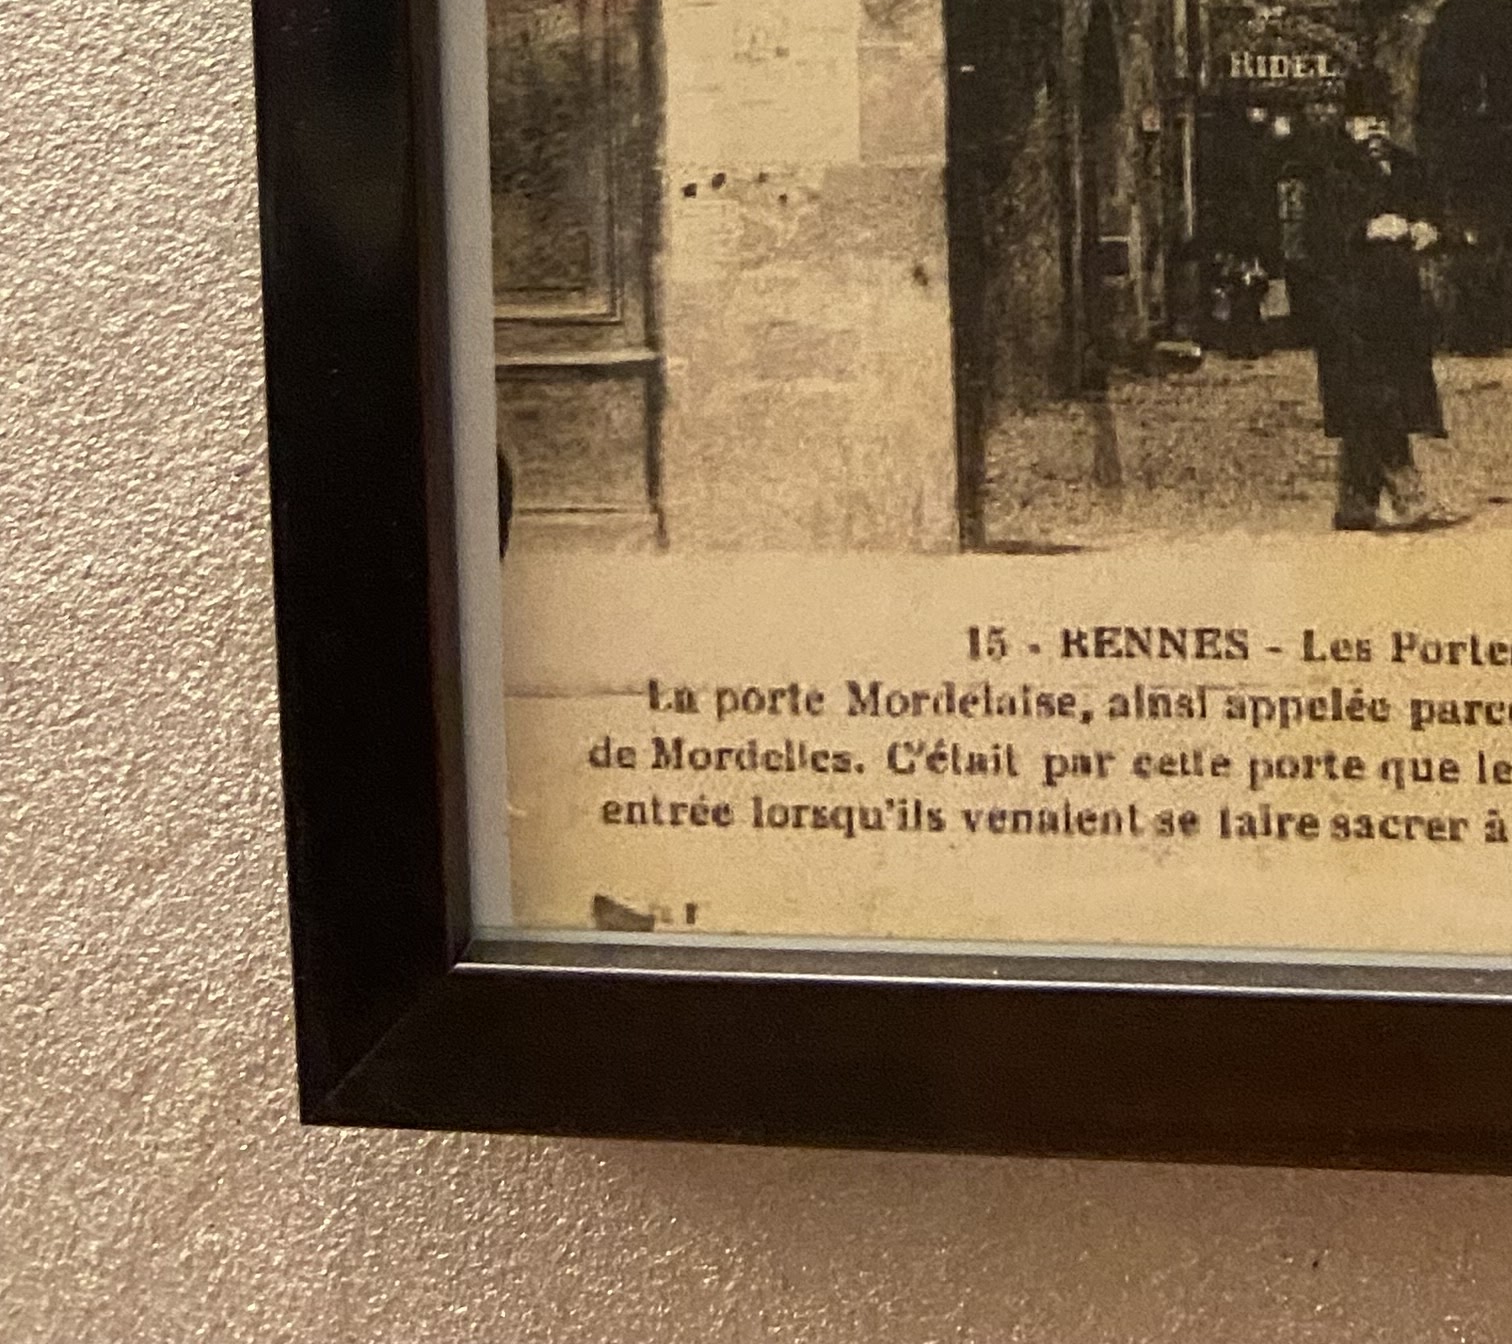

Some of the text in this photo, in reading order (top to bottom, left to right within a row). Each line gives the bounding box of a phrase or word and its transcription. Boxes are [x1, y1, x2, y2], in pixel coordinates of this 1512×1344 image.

[967, 626, 1008, 660] 15
[1061, 627, 1249, 661] RENNES
[1303, 629, 1371, 663] Les
[648, 680, 697, 712] La
[715, 683, 825, 720] porte
[847, 682, 1093, 724] Mordelaise,
[1108, 684, 1207, 720] ainsi
[1225, 687, 1390, 728] appelée
[589, 738, 635, 768] de
[652, 737, 865, 774] Mordelles.
[887, 738, 1018, 777] C'était
[1042, 750, 1114, 786] par
[1132, 748, 1232, 778] cette
[1248, 752, 1366, 791] porte
[1380, 758, 1460, 789] que
[601, 795, 734, 828] entrée
[752, 795, 948, 838] lorsqu'ils
[962, 801, 1141, 836] venaient
[1159, 814, 1199, 838] se
[1218, 806, 1320, 841] faire
[1330, 810, 1470, 843] sacrer
[1484, 811, 1508, 844] à
